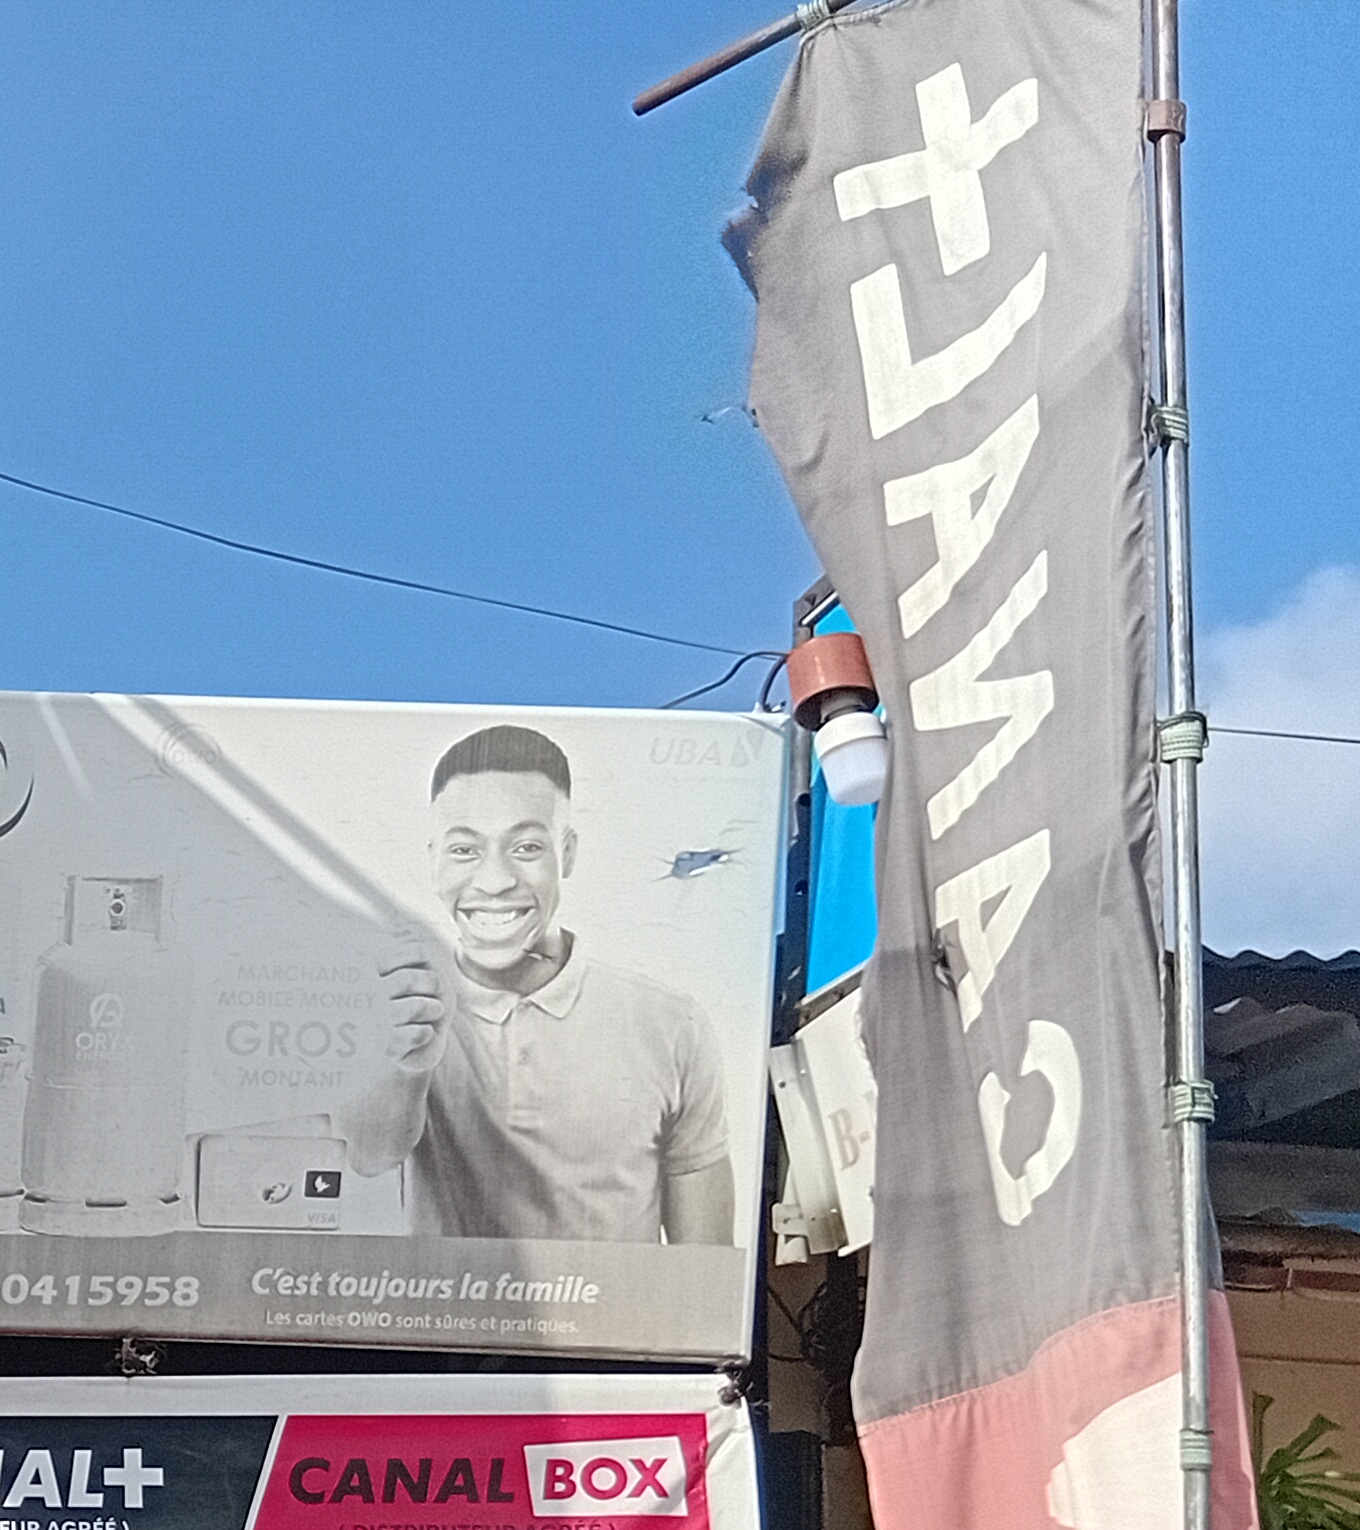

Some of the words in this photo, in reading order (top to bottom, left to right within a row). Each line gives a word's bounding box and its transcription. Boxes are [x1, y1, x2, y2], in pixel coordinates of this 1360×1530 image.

[224, 1018, 358, 1059] GROS
[250, 1266, 323, 1297] C'est
[326, 1270, 453, 1305] toujours
[459, 1271, 488, 1301] la
[493, 1272, 600, 1305] famille
[265, 1309, 291, 1327] Les
[295, 1311, 344, 1328] cartes
[346, 1311, 392, 1329] OWO
[395, 1314, 432, 1330] sont
[434, 1312, 477, 1331] sûres
[479, 1316, 498, 1331] et
[500, 1315, 580, 1337] pratiques.
[287, 1455, 517, 1506] CANAL
[543, 1455, 670, 1501] BOX
